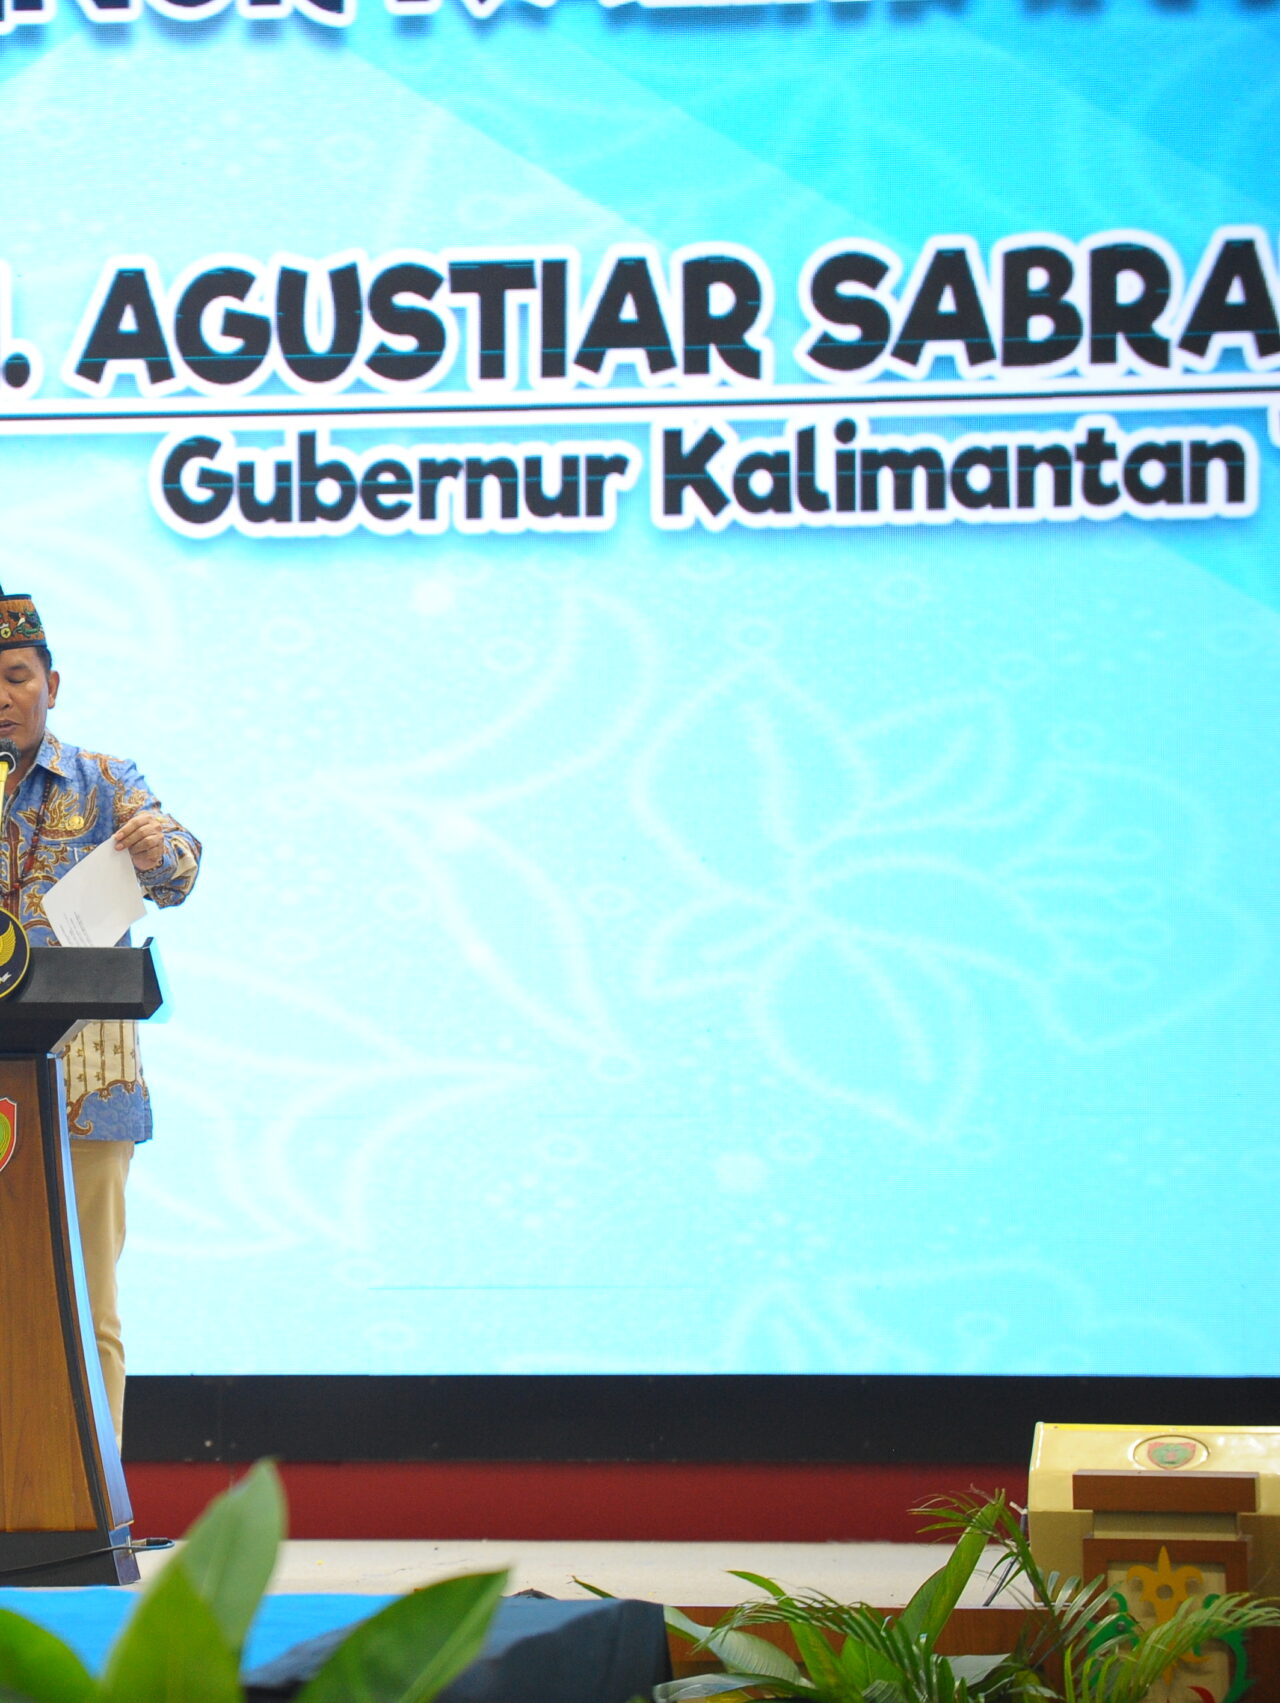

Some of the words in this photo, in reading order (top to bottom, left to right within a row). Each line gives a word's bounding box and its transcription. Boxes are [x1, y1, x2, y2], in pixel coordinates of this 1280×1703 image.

[76, 256, 762, 388] AGUSTIAR
[163, 430, 629, 525] Gubernur
[664, 419, 1246, 517] Kalimantan
